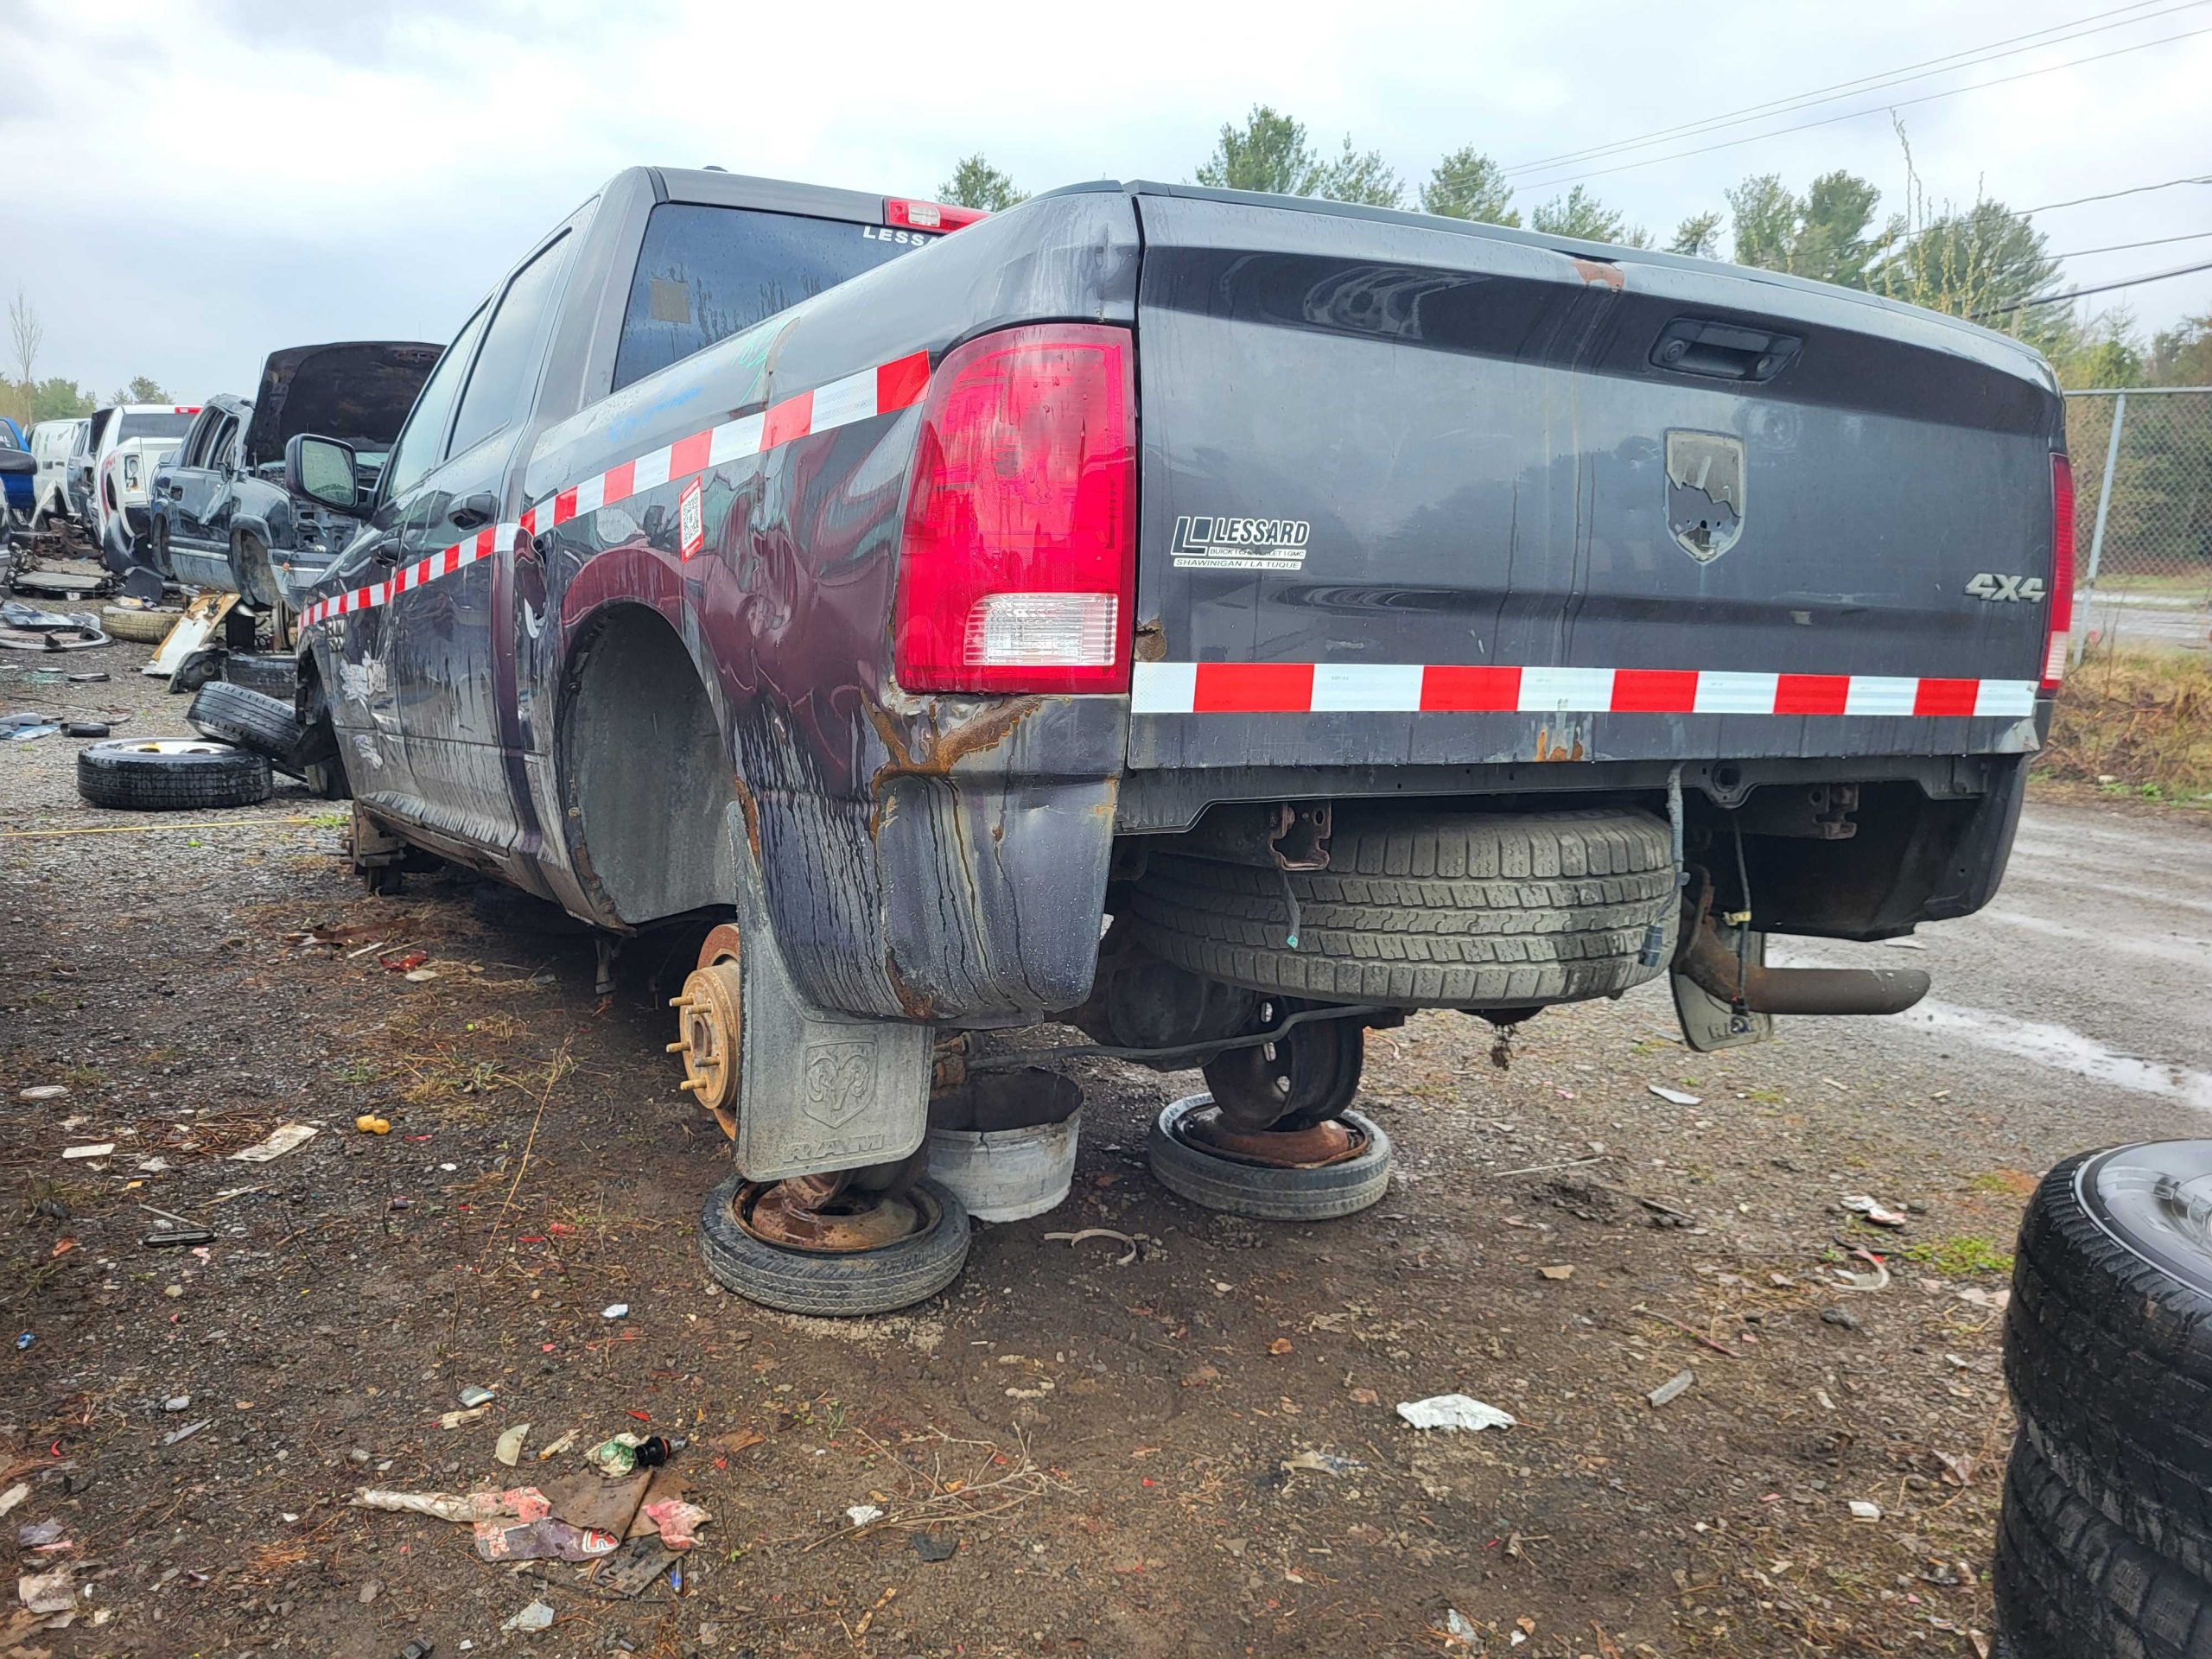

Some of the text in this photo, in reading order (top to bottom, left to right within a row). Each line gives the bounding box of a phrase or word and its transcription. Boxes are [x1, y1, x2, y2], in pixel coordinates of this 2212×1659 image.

[1213, 518, 1310, 546] LESSARD
[1176, 558, 1242, 568] SHAWINIGAN
[1249, 560, 1263, 569] LA
[1266, 561, 1300, 569] TUQUE
[1964, 572, 2047, 603] 4X4
[781, 1133, 885, 1163] RAM
